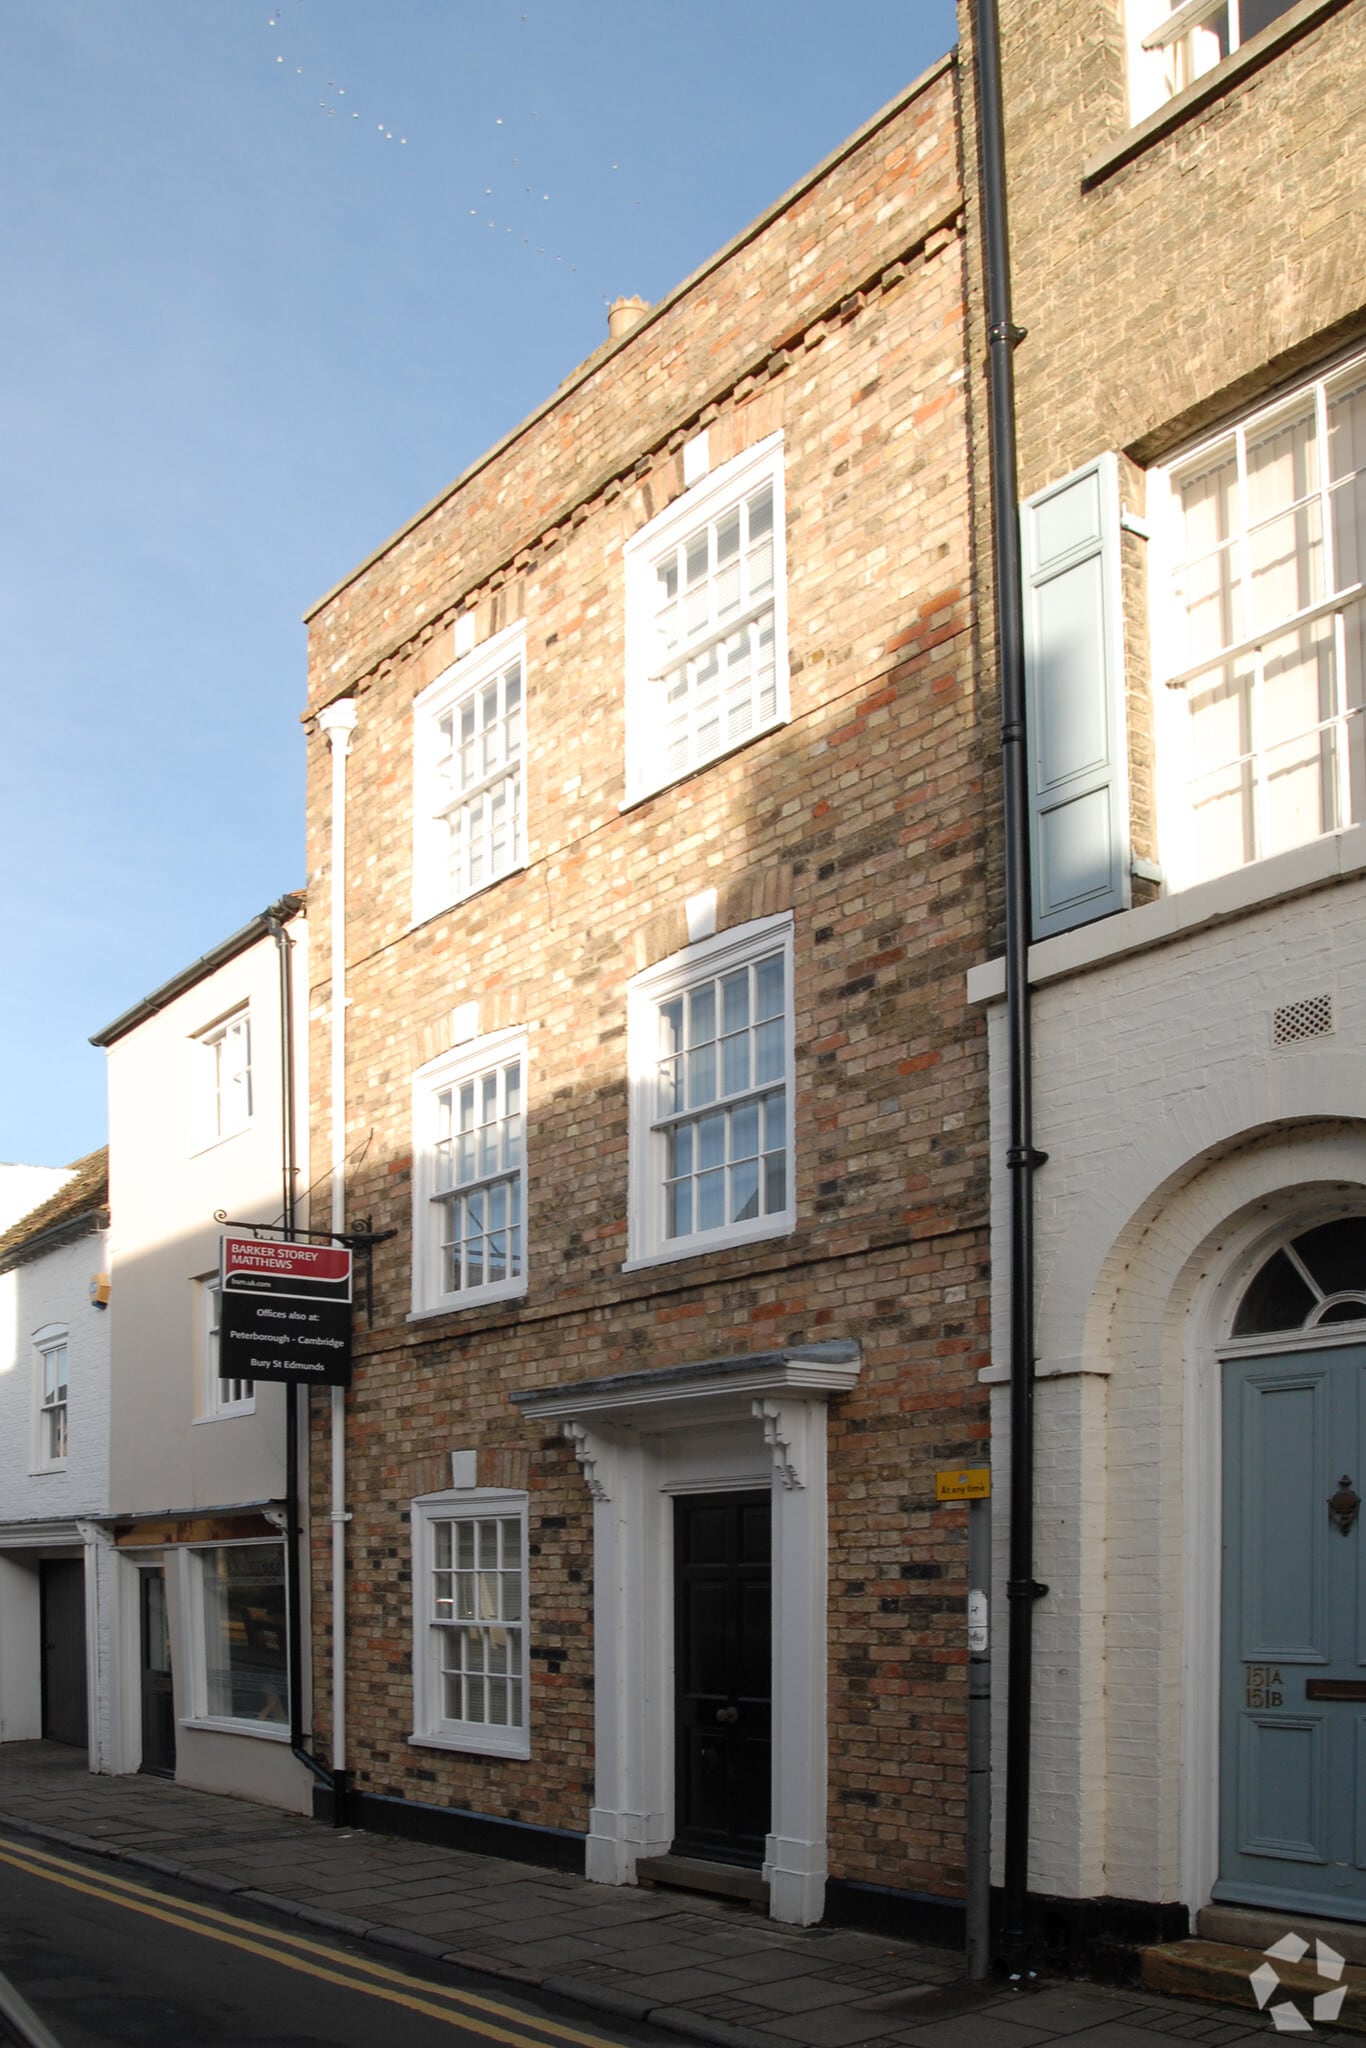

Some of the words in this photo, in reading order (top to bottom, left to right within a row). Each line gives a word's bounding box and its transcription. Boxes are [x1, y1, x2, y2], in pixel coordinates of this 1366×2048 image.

[231, 1244, 275, 1257] BARKER
[277, 1249, 318, 1261] STOREY
[231, 1255, 293, 1269] MATTHEWS
[256, 1308, 287, 1319] Offices
[288, 1311, 307, 1321] also
[308, 1313, 320, 1321] at:
[230, 1330, 290, 1345] Peterborough
[297, 1335, 345, 1349] Cambridge
[250, 1358, 271, 1369] Bury
[272, 1359, 282, 1368] St
[283, 1361, 325, 1372] Edmunds
[1246, 1665, 1284, 1687] 151A
[1246, 1688, 1284, 1709] 151B
